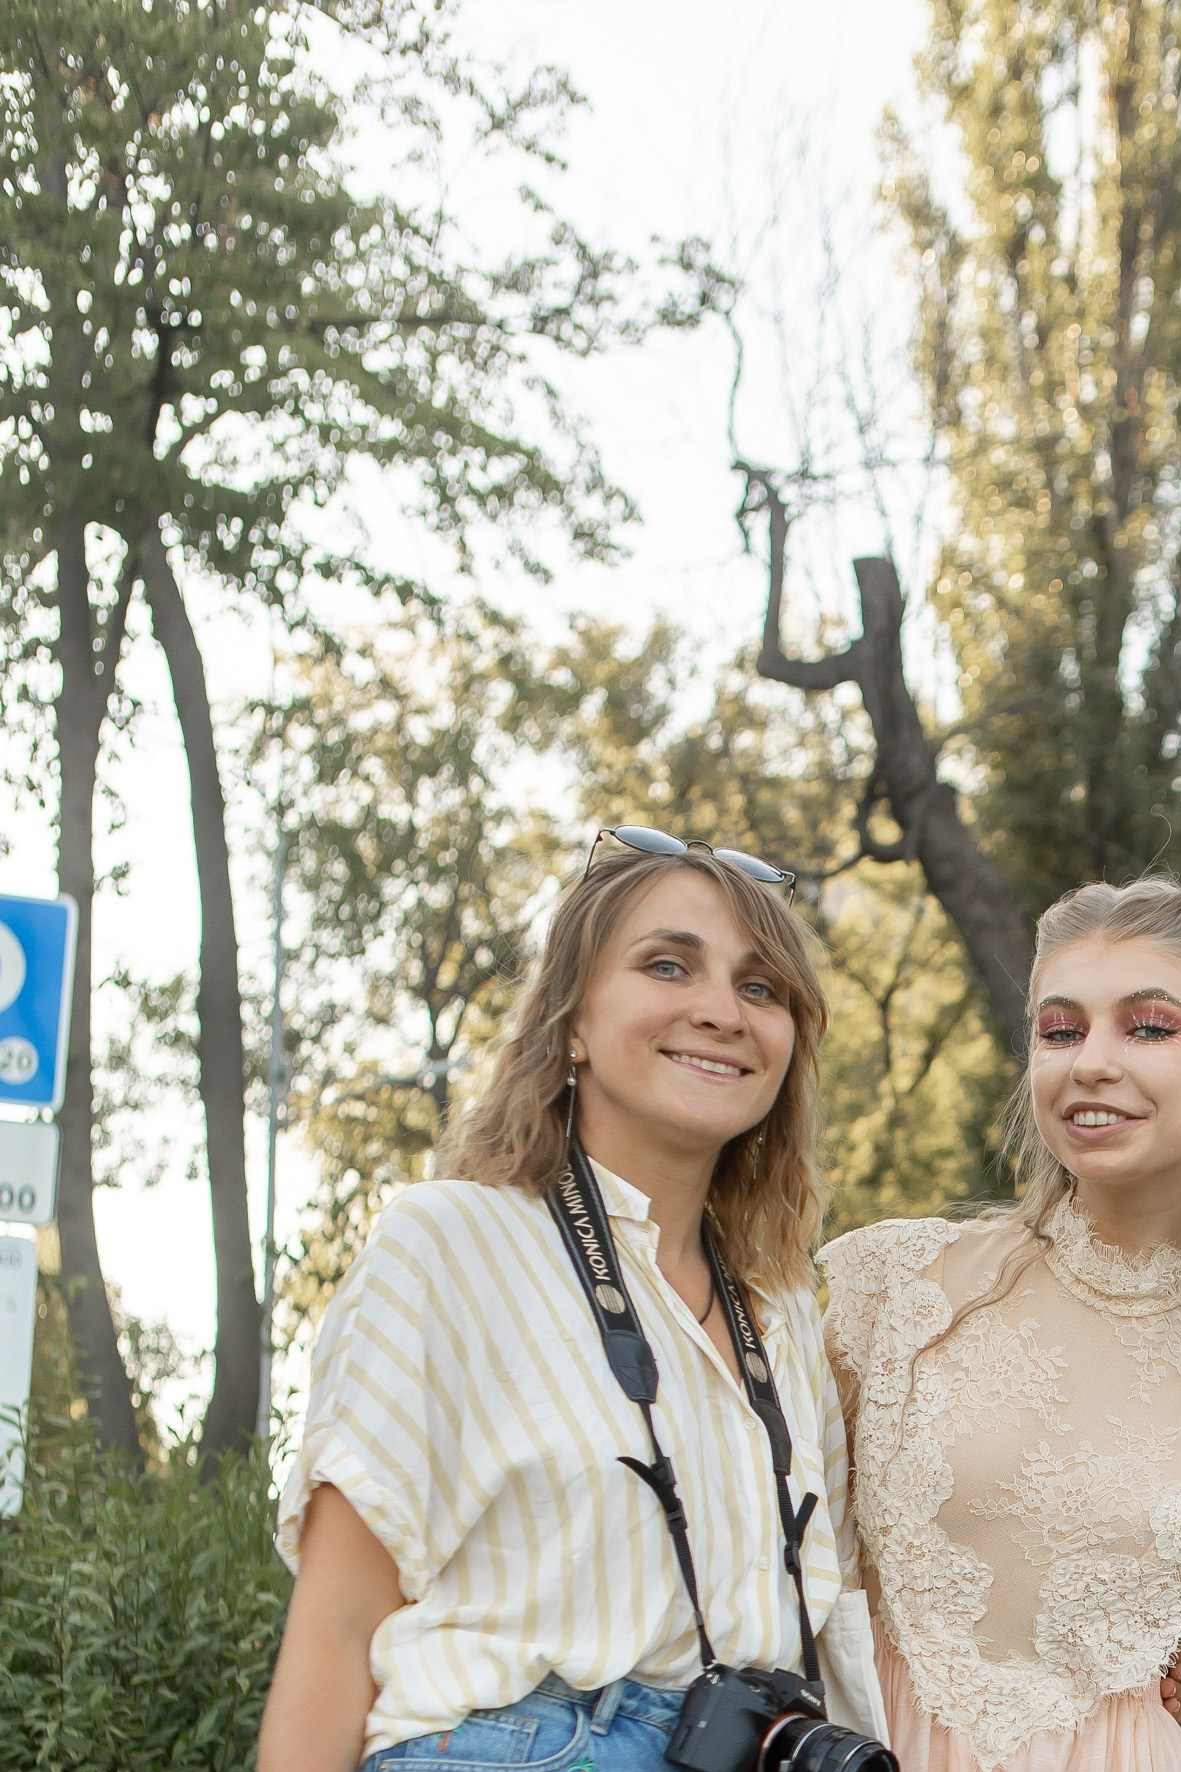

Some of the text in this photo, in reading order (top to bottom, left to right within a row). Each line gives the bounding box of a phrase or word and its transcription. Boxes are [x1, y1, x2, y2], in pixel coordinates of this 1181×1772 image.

[558, 1163, 612, 1281] KONICA MINOL
[728, 1285, 757, 1350] KONICA
